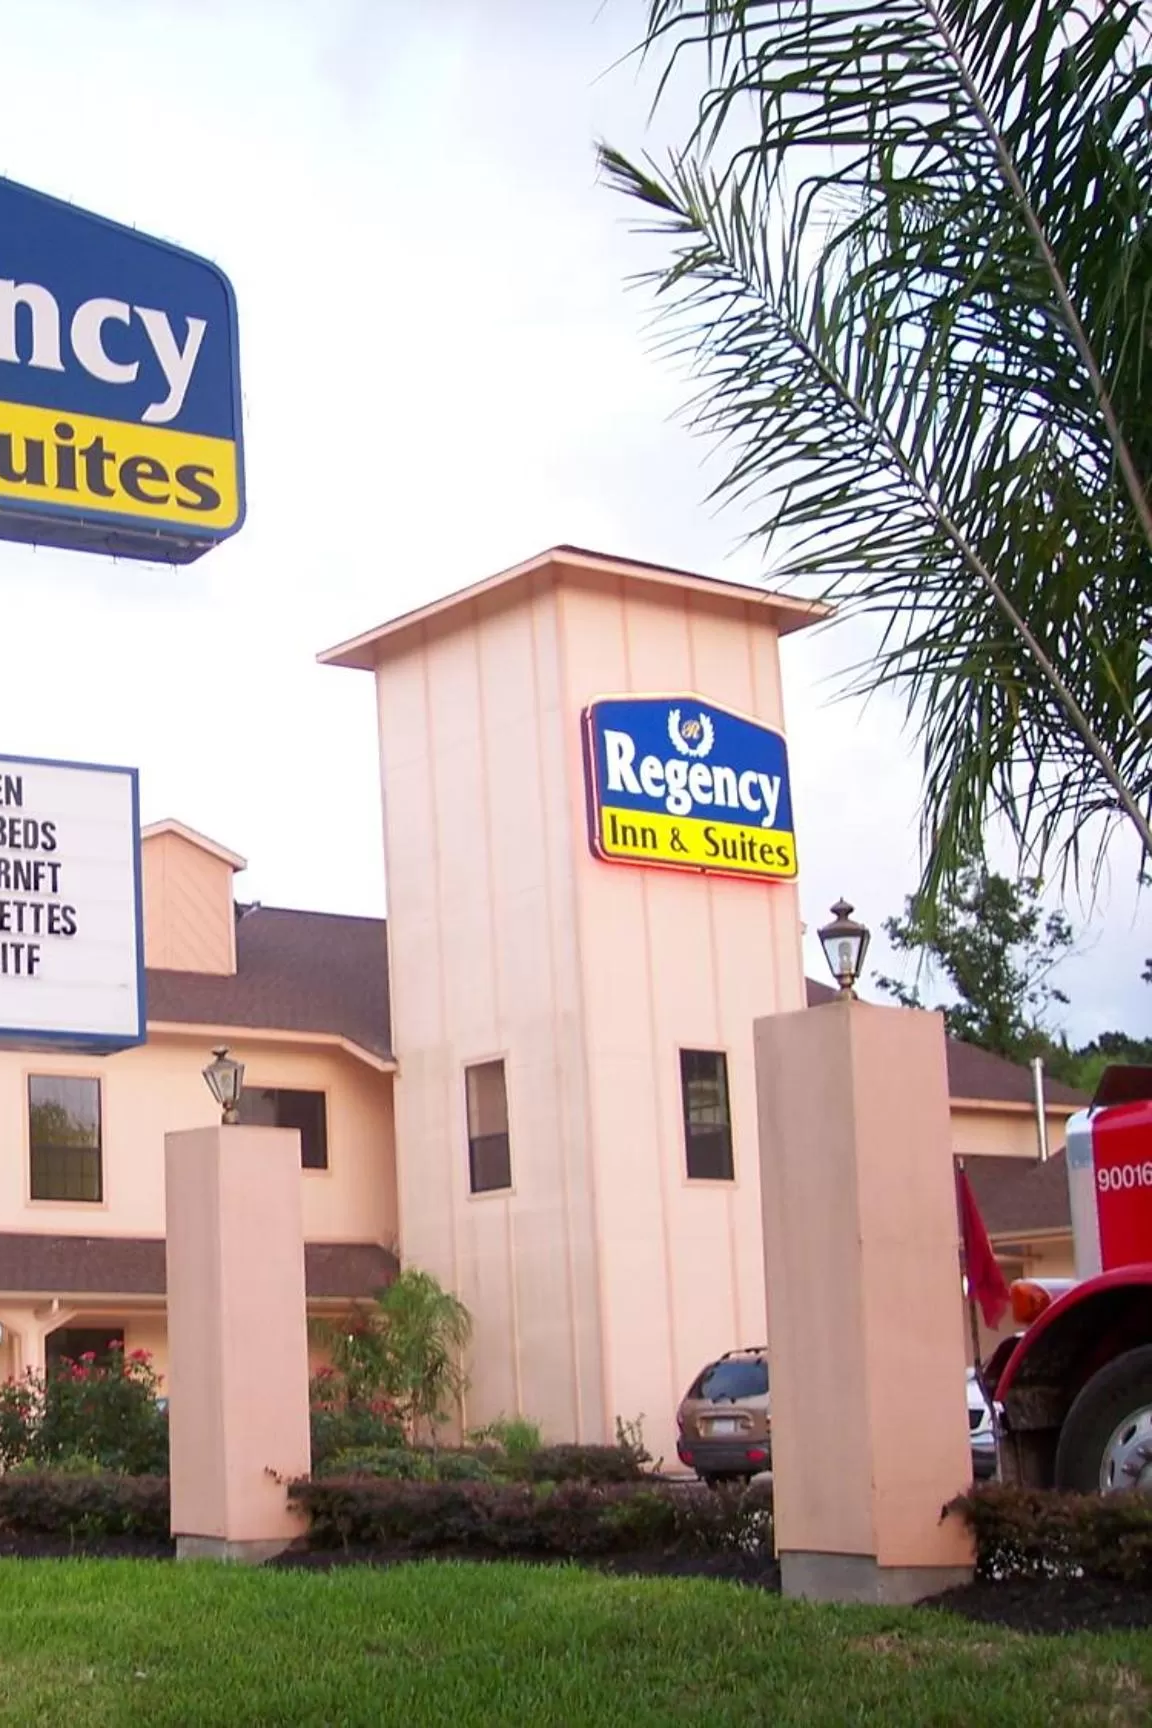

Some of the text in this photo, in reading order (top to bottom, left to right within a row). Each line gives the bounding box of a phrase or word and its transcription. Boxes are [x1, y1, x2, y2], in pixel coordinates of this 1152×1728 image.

[604, 730, 781, 828] Regency
[610, 814, 790, 867] Inn & Suites
